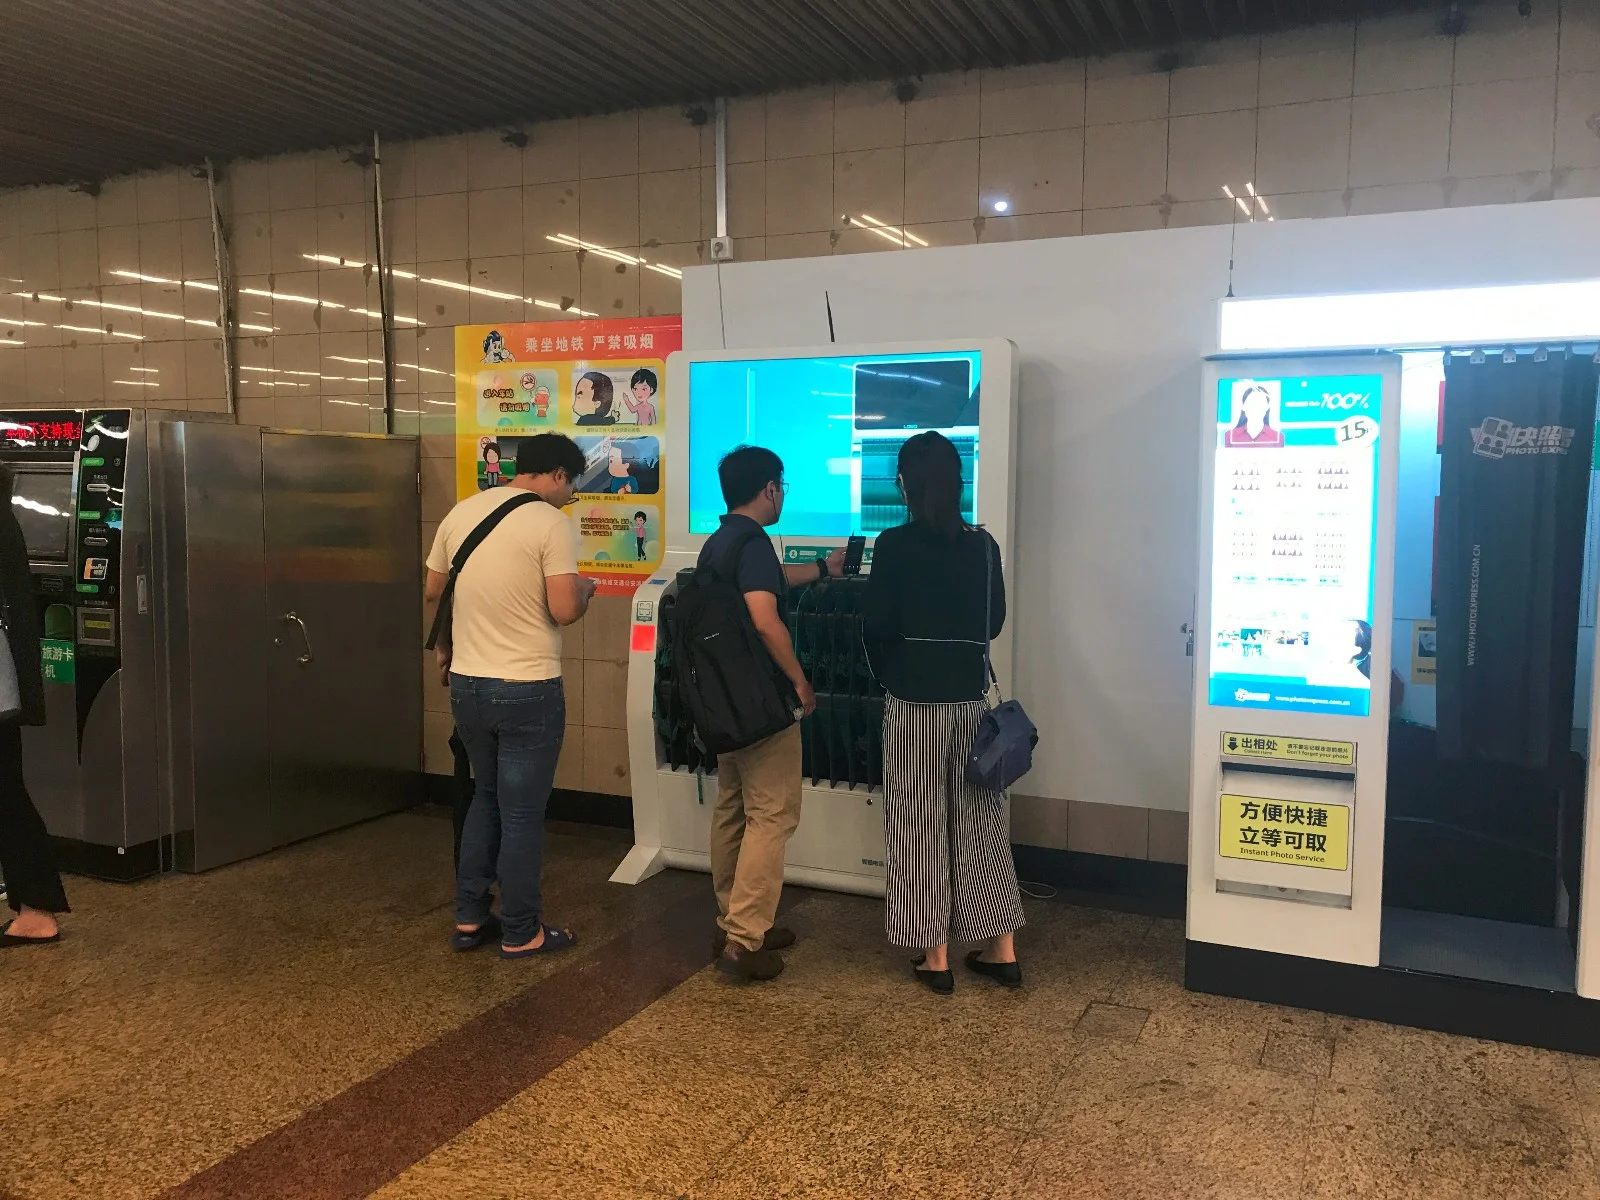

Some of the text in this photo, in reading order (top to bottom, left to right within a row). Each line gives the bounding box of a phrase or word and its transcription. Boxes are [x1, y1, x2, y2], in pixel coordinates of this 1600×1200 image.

[525, 333, 654, 353] 乘坐地铁 严禁吸烟
[42, 645, 74, 661] 旅游卡
[41, 664, 56, 678] 机
[1241, 737, 1278, 751] 出相处
[1240, 801, 1328, 827] 方便快捷
[1239, 826, 1327, 853] 立等可取
[1240, 847, 1325, 863] Instant Photo Service
